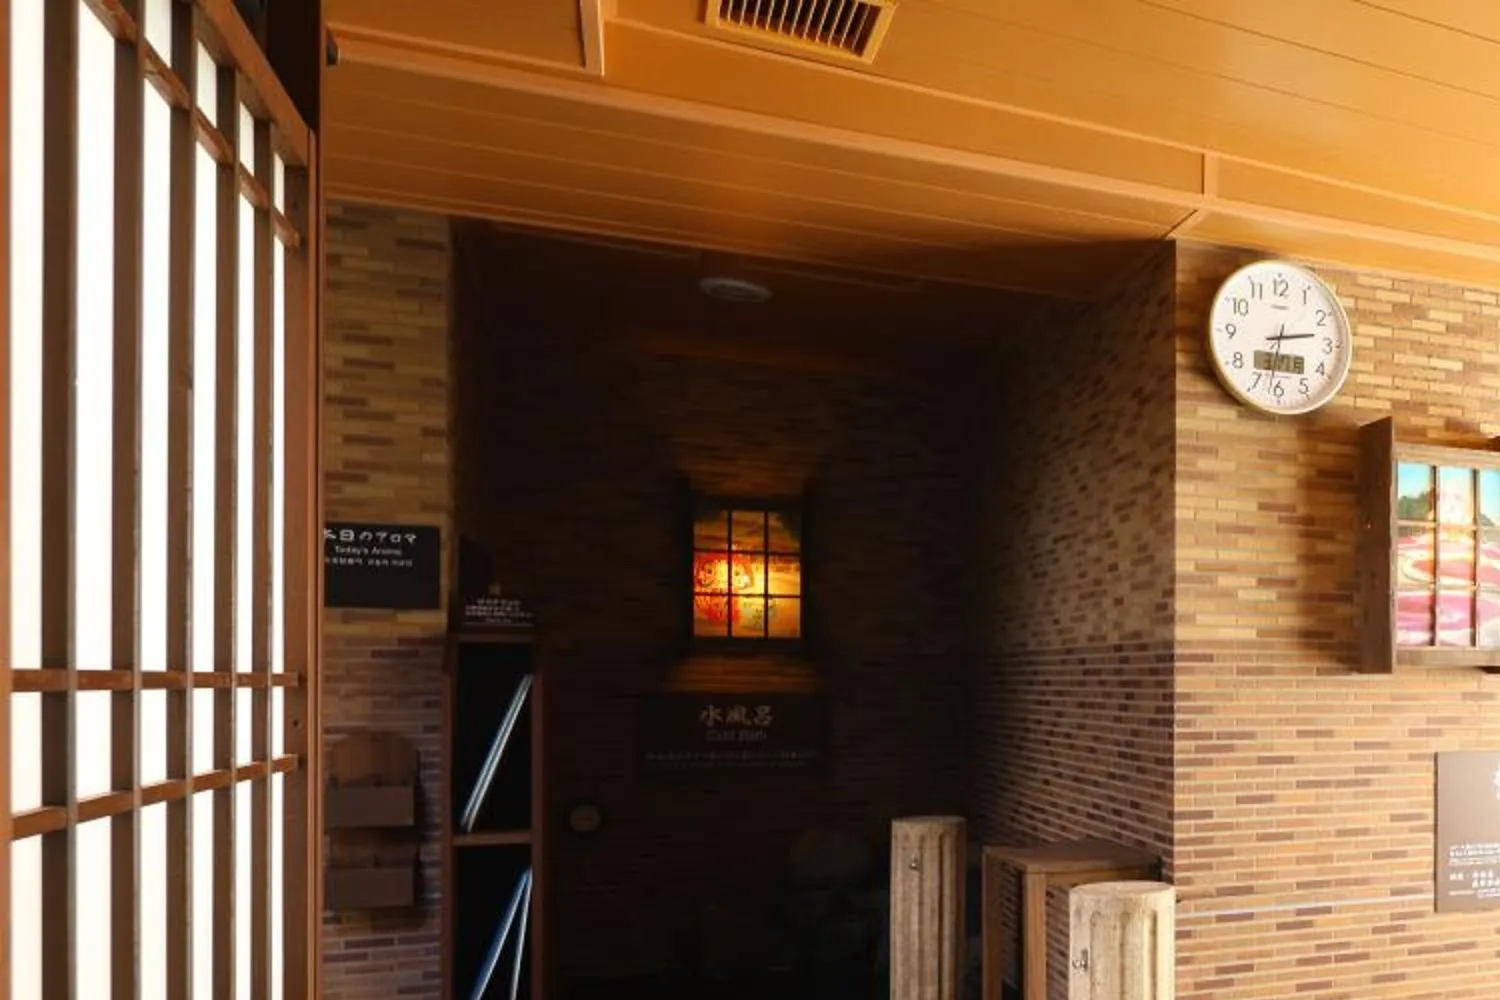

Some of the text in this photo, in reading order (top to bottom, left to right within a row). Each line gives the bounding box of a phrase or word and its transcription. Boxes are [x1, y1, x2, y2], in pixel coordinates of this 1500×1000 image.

[1250, 281, 1263, 300] 11
[1273, 279, 1289, 297] 12
[1232, 298, 1248, 316] 10
[1315, 309, 1326, 326] 2
[1225, 323, 1237, 339] 9
[1322, 338, 1333, 354] 3
[1232, 352, 1244, 368] 8
[1315, 361, 1325, 376] 4
[1252, 372, 1262, 389] 7
[1273, 380, 1285, 398] 6
[1298, 377, 1309, 394] 5
